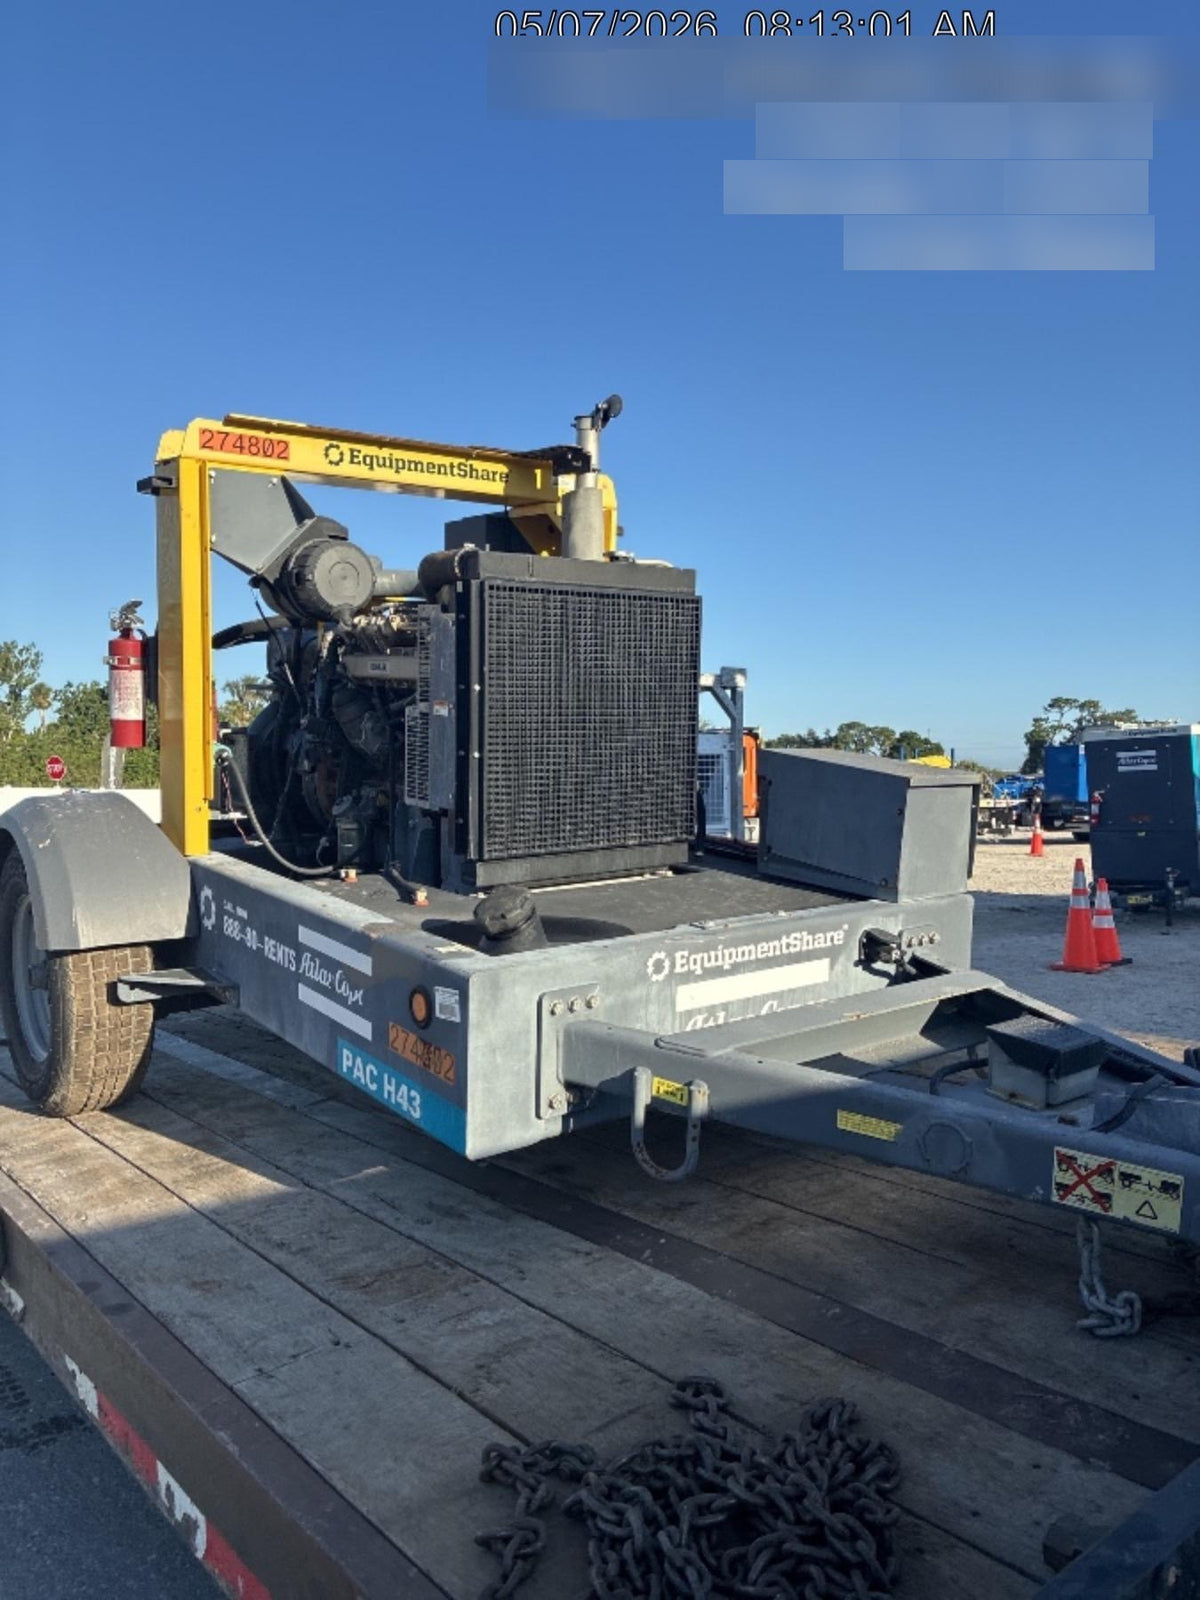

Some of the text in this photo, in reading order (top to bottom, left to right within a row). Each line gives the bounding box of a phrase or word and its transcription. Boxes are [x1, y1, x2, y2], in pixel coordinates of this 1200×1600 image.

[200, 429, 289, 460] 274802
[347, 446, 509, 483] EquipmentShare
[674, 927, 846, 975] EquipmentShare
[298, 952, 332, 989] Atlas
[342, 1048, 421, 1120] PAC H43
